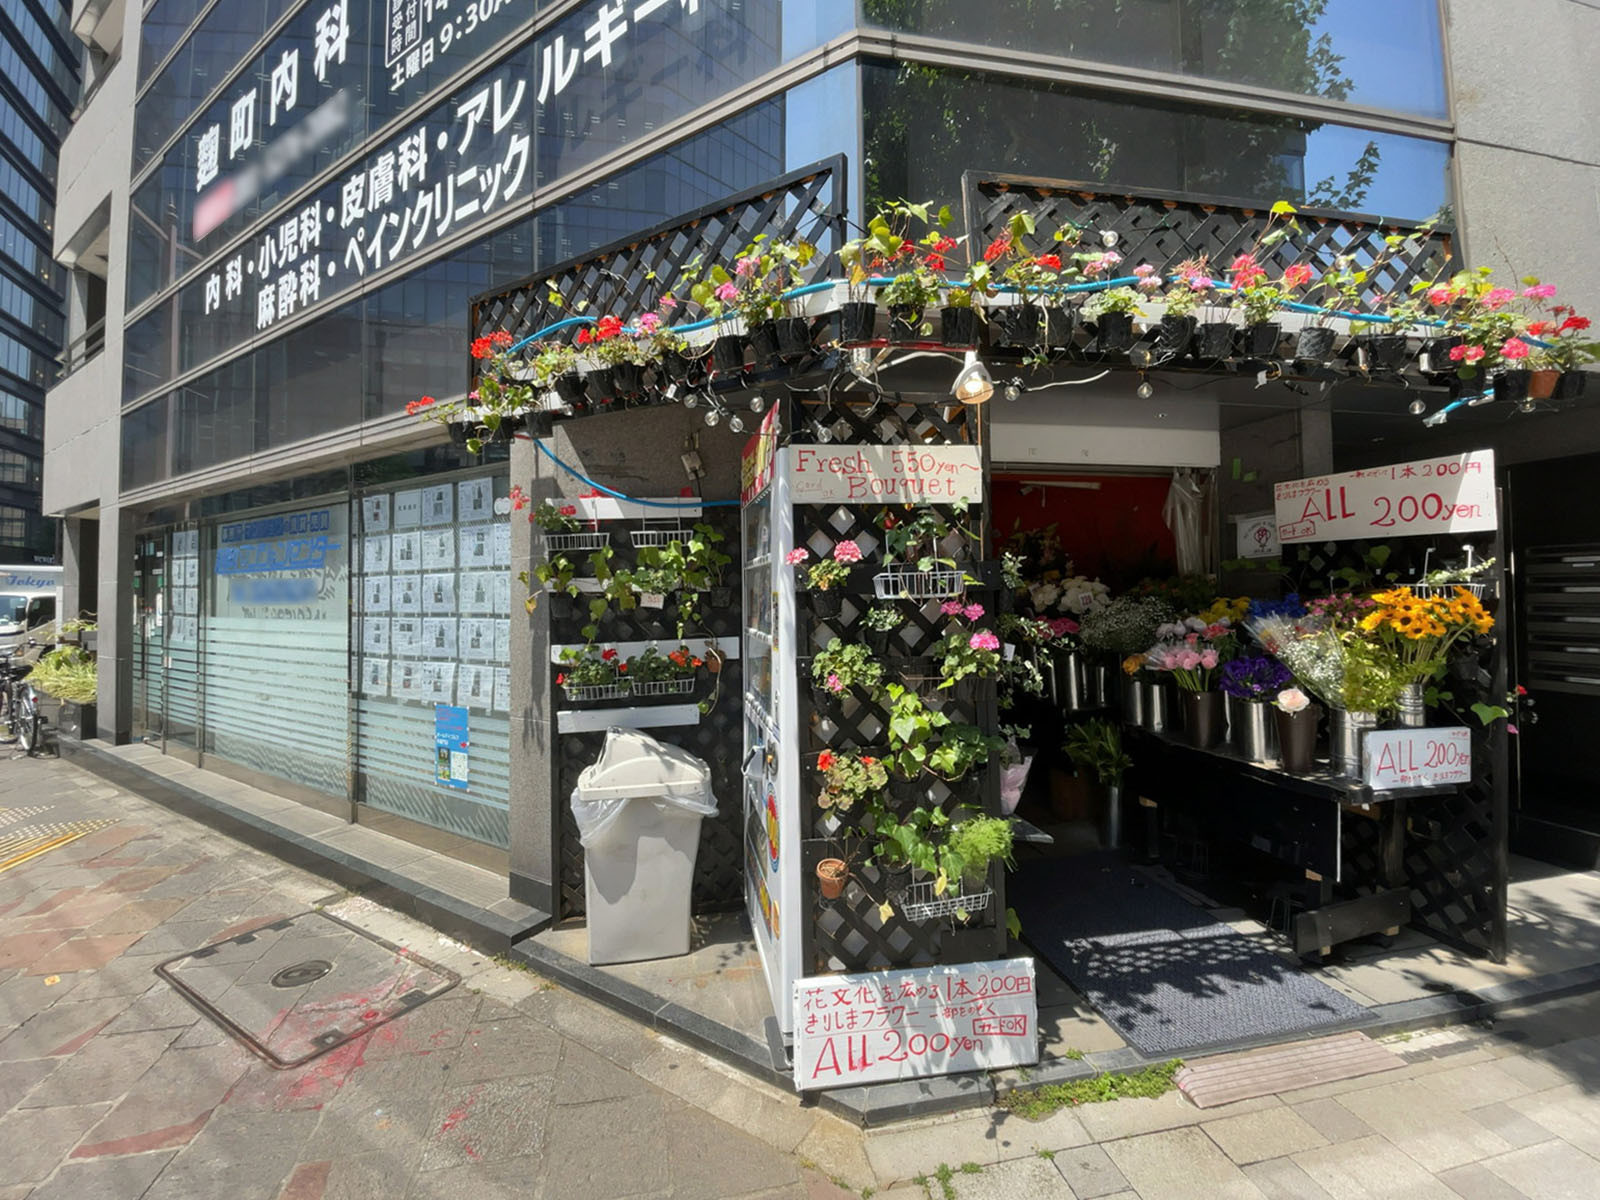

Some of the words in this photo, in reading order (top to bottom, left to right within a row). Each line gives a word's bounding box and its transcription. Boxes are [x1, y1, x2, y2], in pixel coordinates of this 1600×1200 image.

[205, 0, 698, 315] 内科・小児科・皮膚科・アレルギー
[795, 449, 873, 474] Fresh
[847, 476, 956, 499] Bouquet
[1300, 486, 1356, 522] ALL
[1375, 740, 1419, 776] ALL
[804, 1006, 920, 1034] きりしまフラワー
